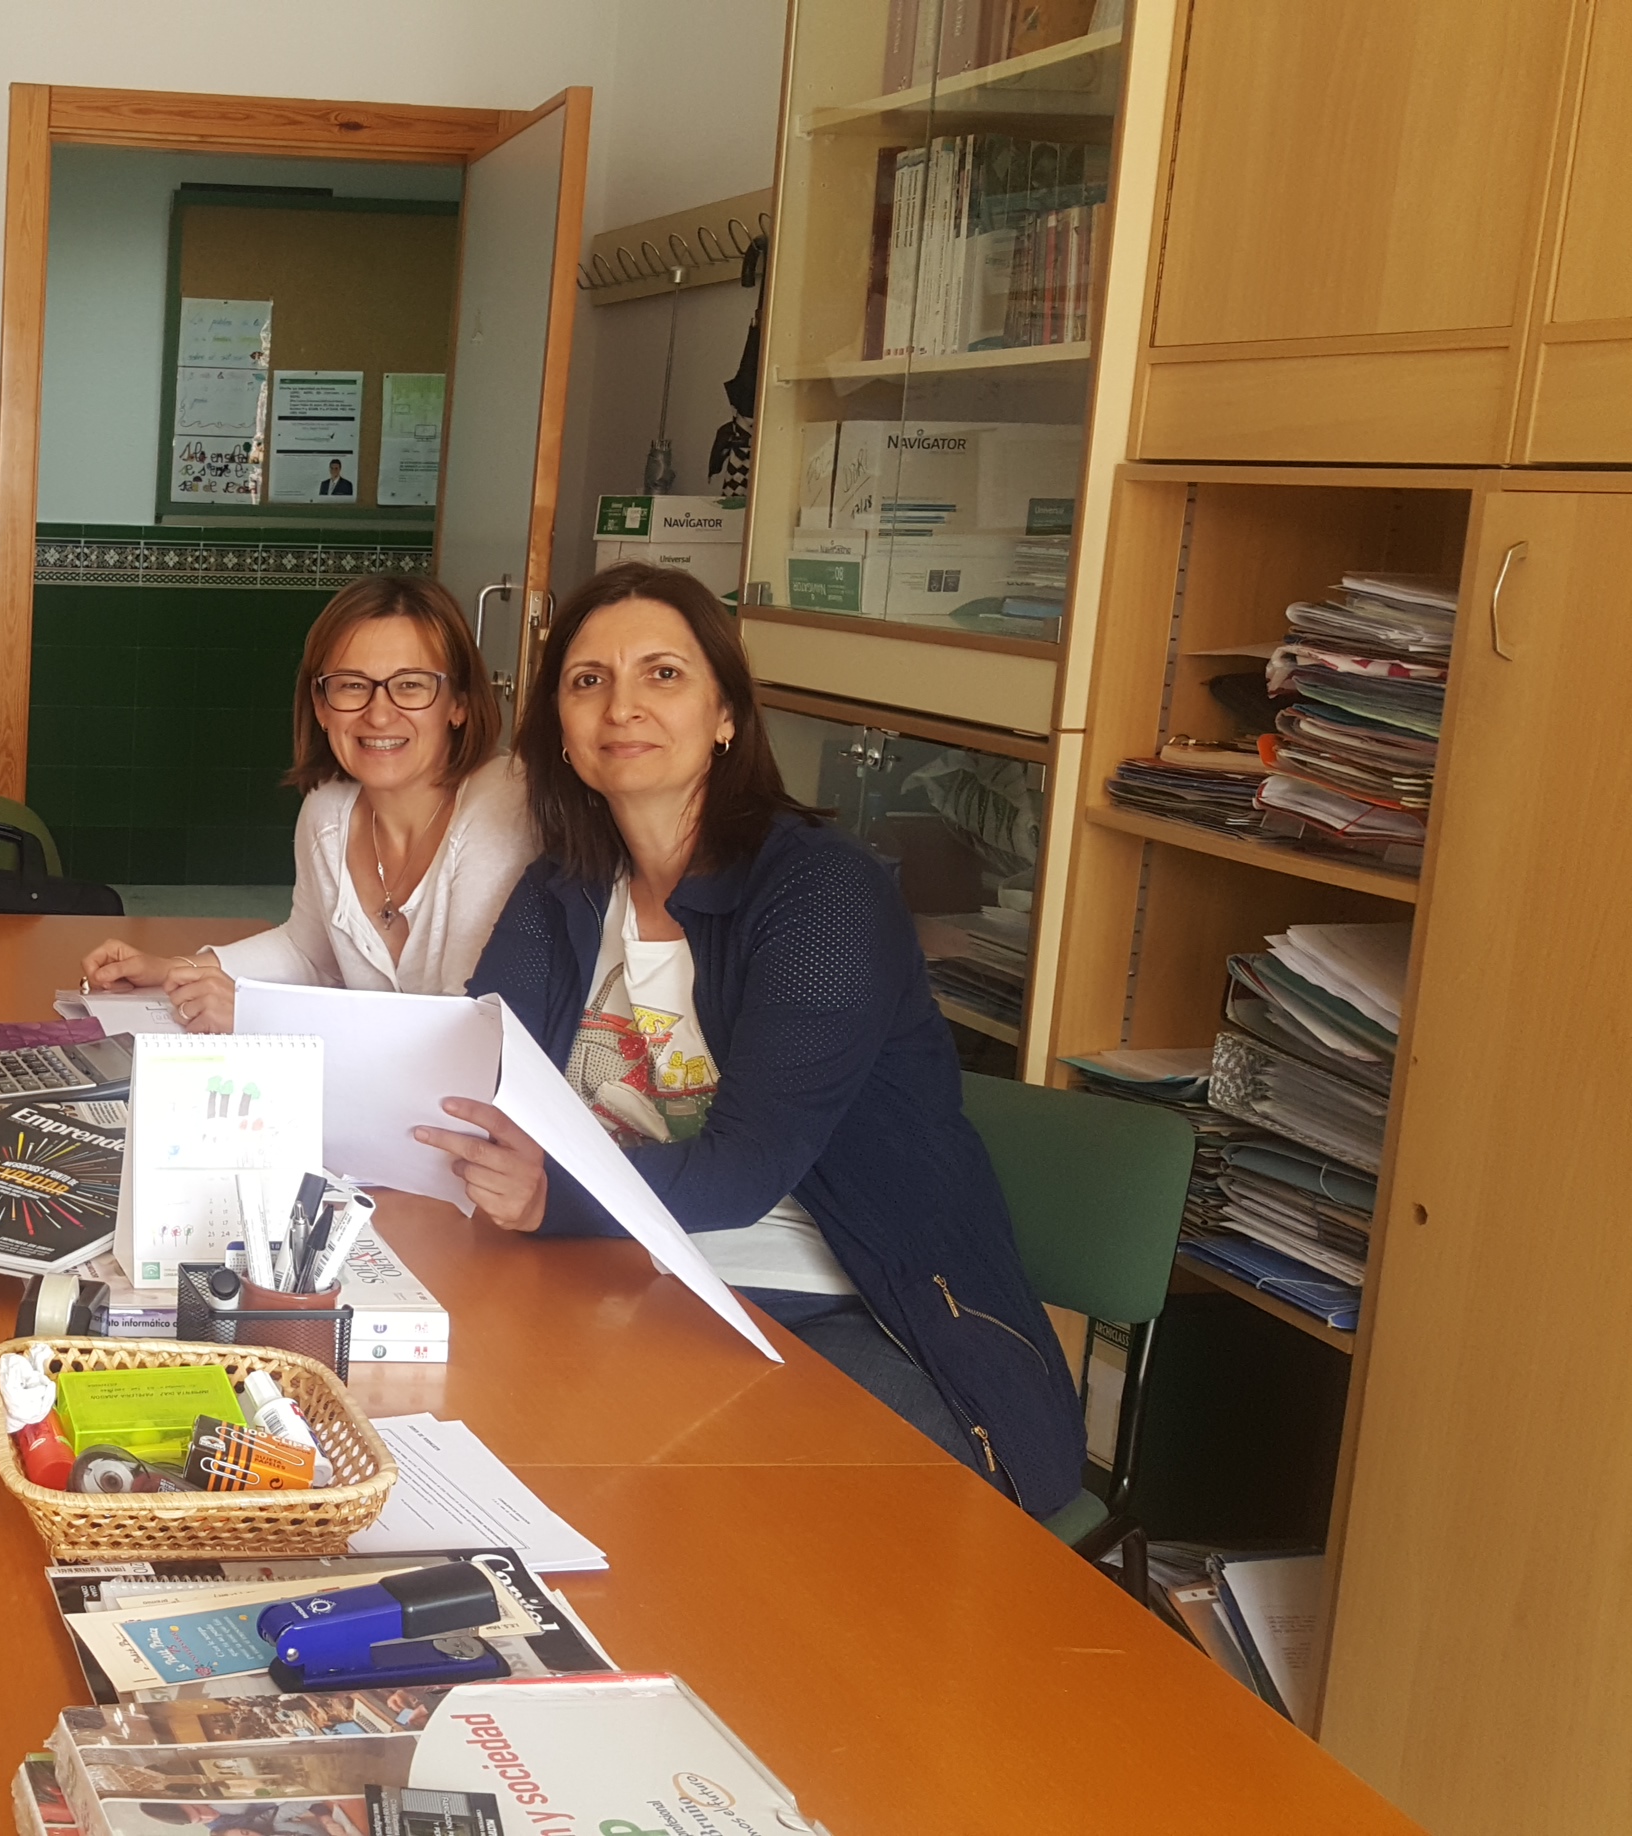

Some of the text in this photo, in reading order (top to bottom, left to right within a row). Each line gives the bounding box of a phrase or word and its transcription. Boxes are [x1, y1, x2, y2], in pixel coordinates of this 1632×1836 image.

[887, 433, 966, 450] NAVIGATOR
[10, 1108, 126, 1152] Emprende
[46, 1168, 70, 1182] PUNTO
[68, 1178, 79, 1186] DE
[356, 1238, 402, 1279] DINERO
[122, 1318, 170, 1328] informático
[243, 1427, 268, 1438] 100
[272, 1435, 312, 1451] CLIPS
[254, 1458, 286, 1470] PAPELES
[450, 1713, 548, 1804] sociedad
[686, 1774, 724, 1809] futuro
[526, 1811, 576, 1824] y
